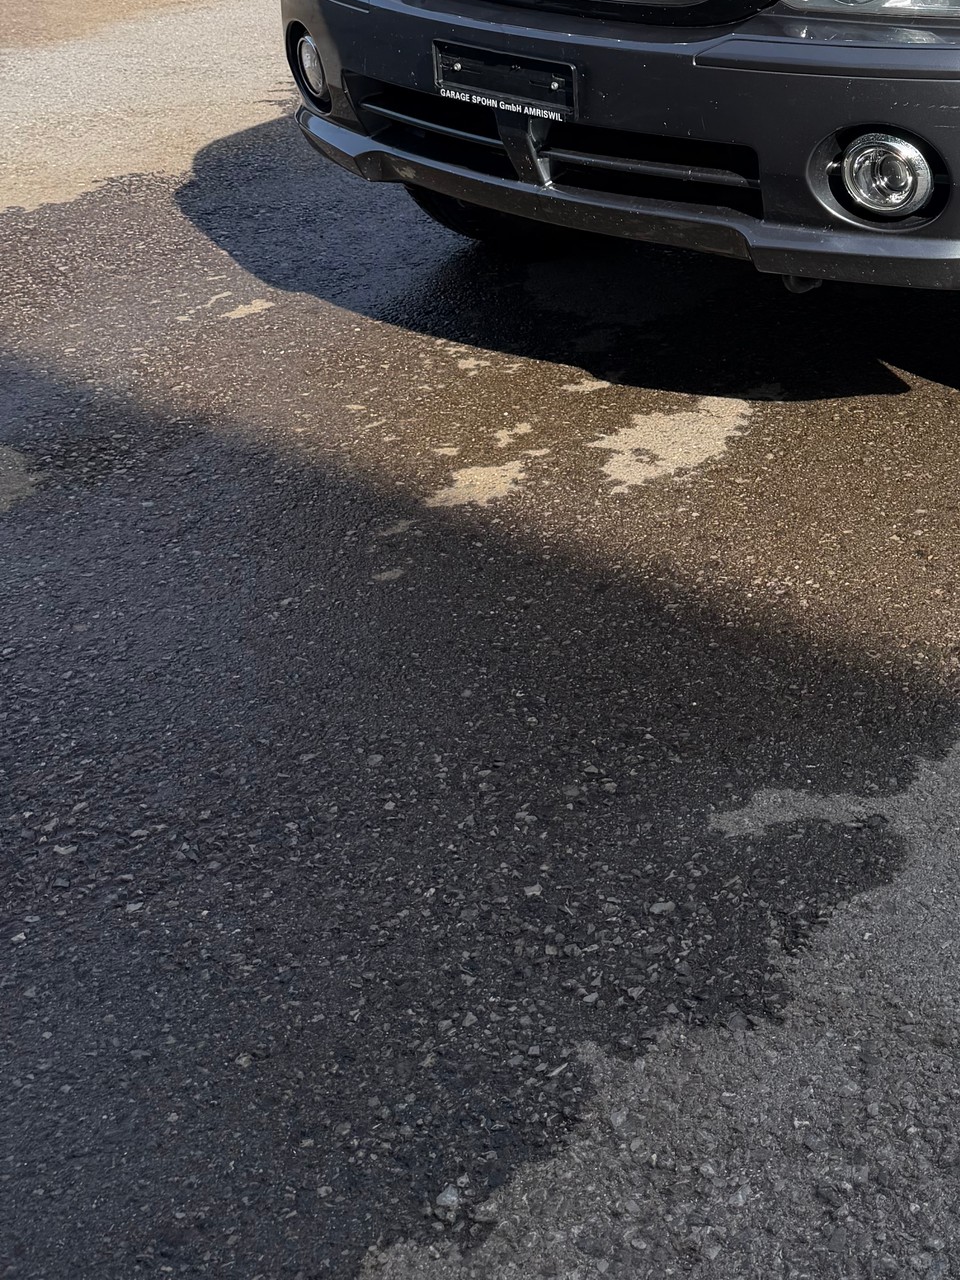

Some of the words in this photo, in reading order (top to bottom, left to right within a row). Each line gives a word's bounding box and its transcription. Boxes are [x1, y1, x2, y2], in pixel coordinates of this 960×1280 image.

[440, 88, 471, 102] GARAGE
[471, 95, 498, 108] SPOHN
[499, 101, 522, 113] GmbH
[523, 106, 563, 122] AMRISWIL
